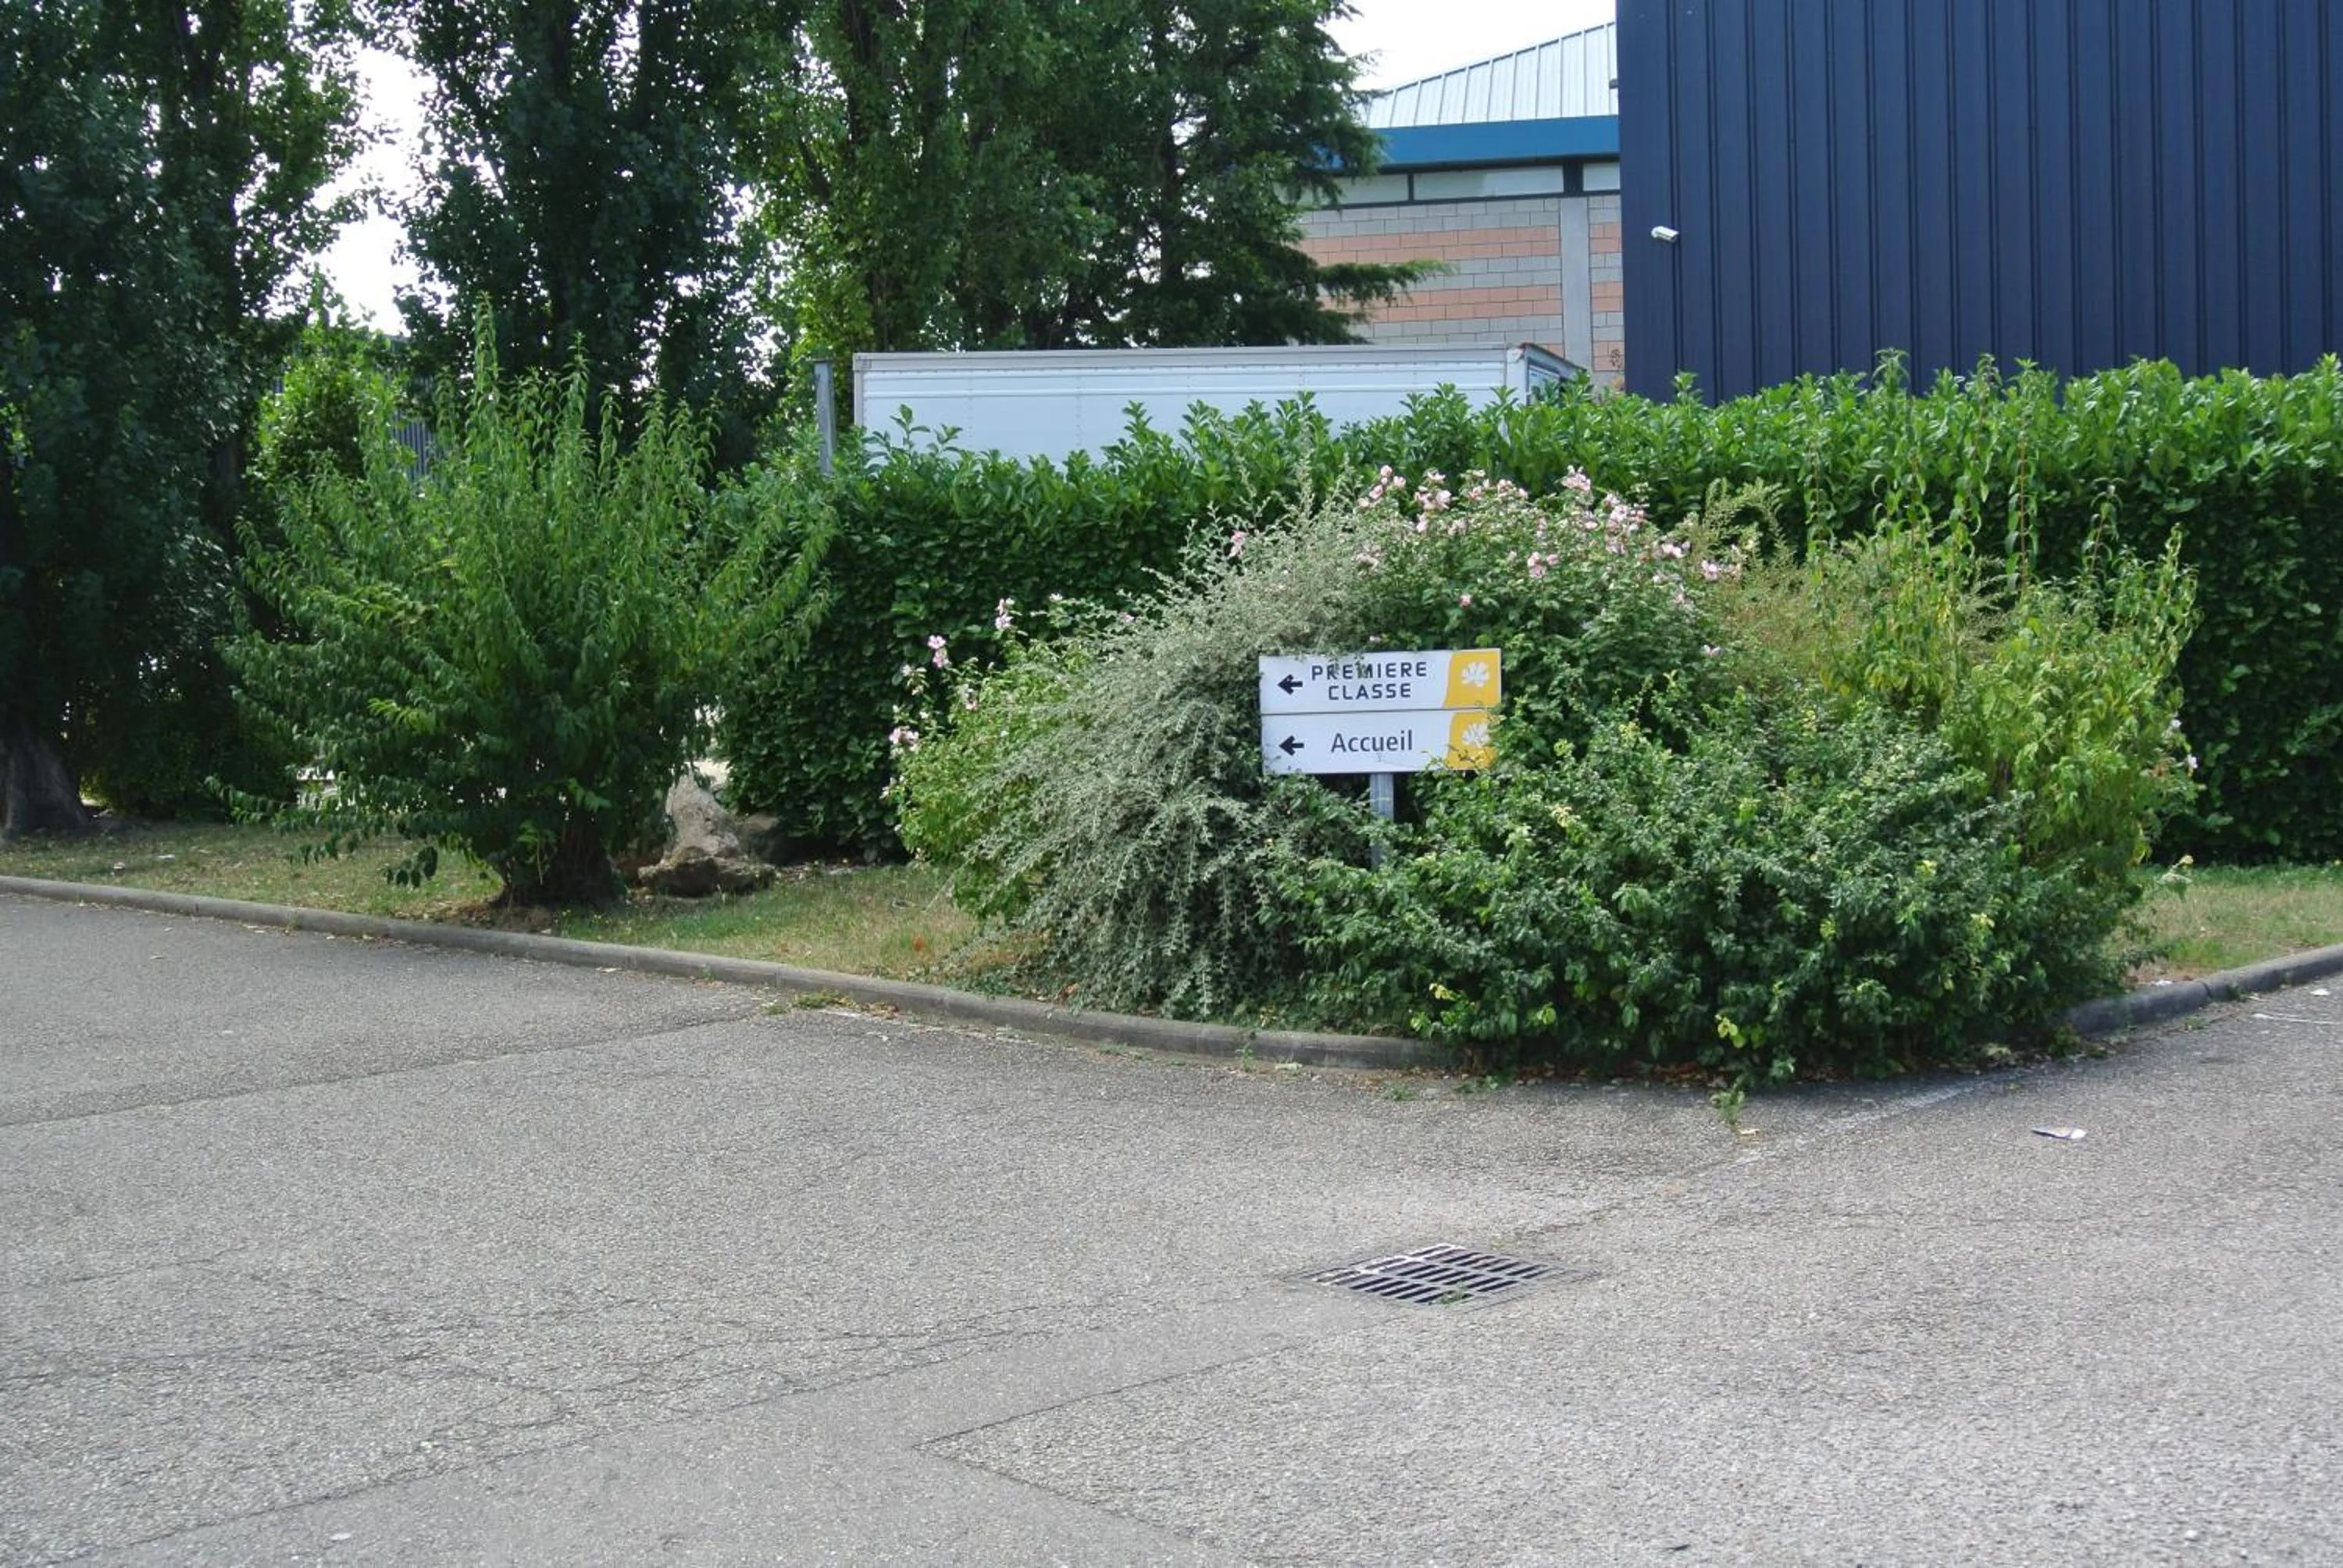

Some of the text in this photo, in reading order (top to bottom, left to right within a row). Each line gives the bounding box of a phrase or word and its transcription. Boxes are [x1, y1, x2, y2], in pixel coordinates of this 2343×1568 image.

[1311, 661, 1428, 681] PREMIERE
[1328, 683, 1412, 700] CLASSE
[1331, 729, 1413, 753] Accueil
